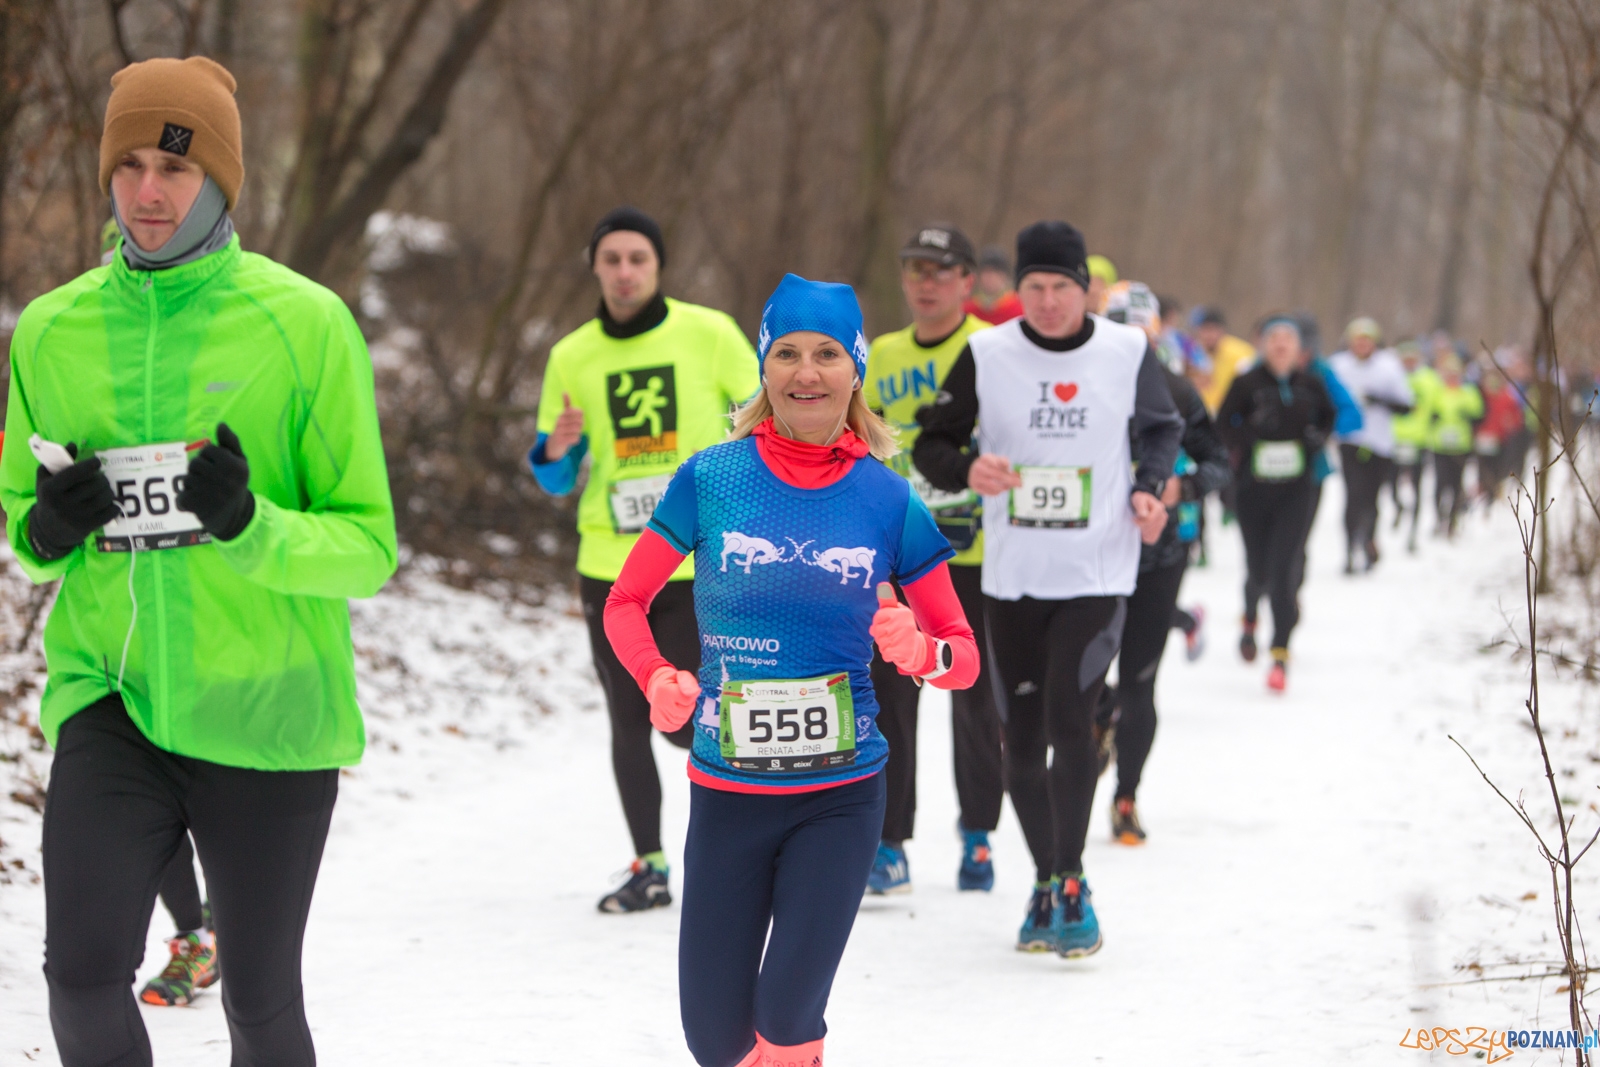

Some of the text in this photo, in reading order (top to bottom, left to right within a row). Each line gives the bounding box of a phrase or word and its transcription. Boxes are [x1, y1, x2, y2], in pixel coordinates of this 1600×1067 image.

[1038, 381, 1050, 403] I
[623, 491, 662, 519] 38
[1033, 486, 1067, 509] 99
[137, 521, 167, 532] KAMIL
[739, 654, 778, 668] biegowo
[749, 706, 828, 743] 558
[757, 745, 794, 756] RENATA
[802, 744, 822, 754] PNB
